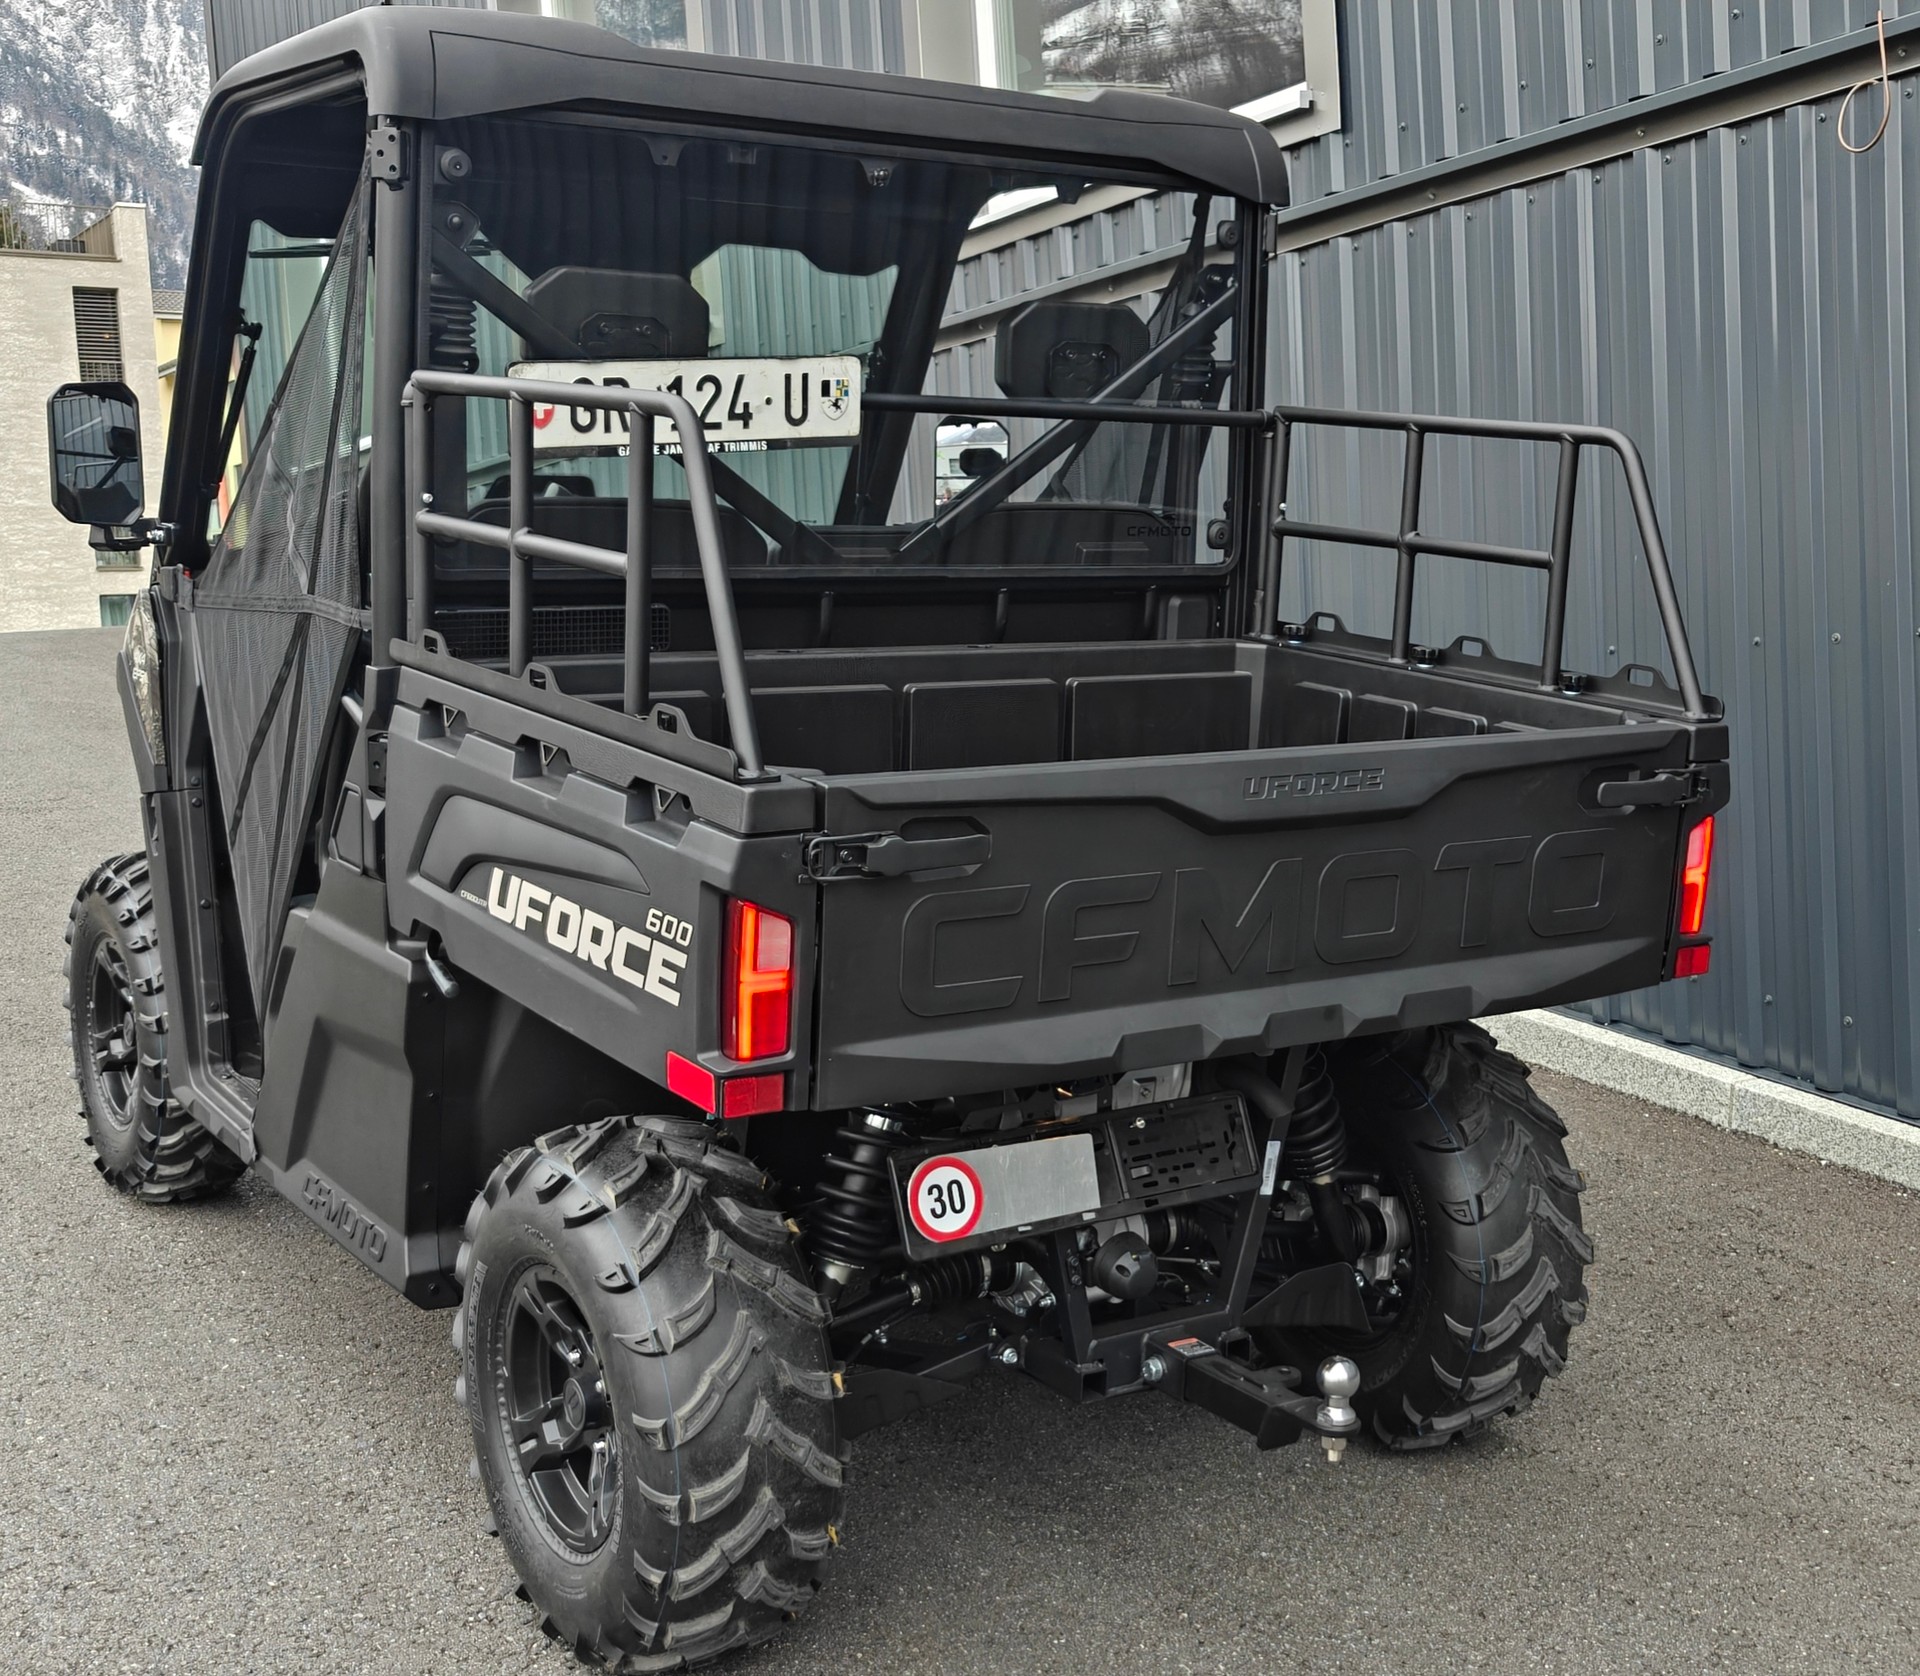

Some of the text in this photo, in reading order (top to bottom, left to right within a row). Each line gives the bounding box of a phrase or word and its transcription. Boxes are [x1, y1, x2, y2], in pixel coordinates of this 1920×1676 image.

[723, 440, 768, 453] TRIMMIS
[1126, 525, 1191, 538] CFMOTO
[1243, 767, 1385, 800] UFORCE
[488, 866, 688, 1007] UFORCE
[645, 907, 694, 947] 600
[899, 827, 1616, 1018] CFMOTO
[302, 1170, 388, 1264] CFMOTO
[926, 1178, 967, 1221] 30
